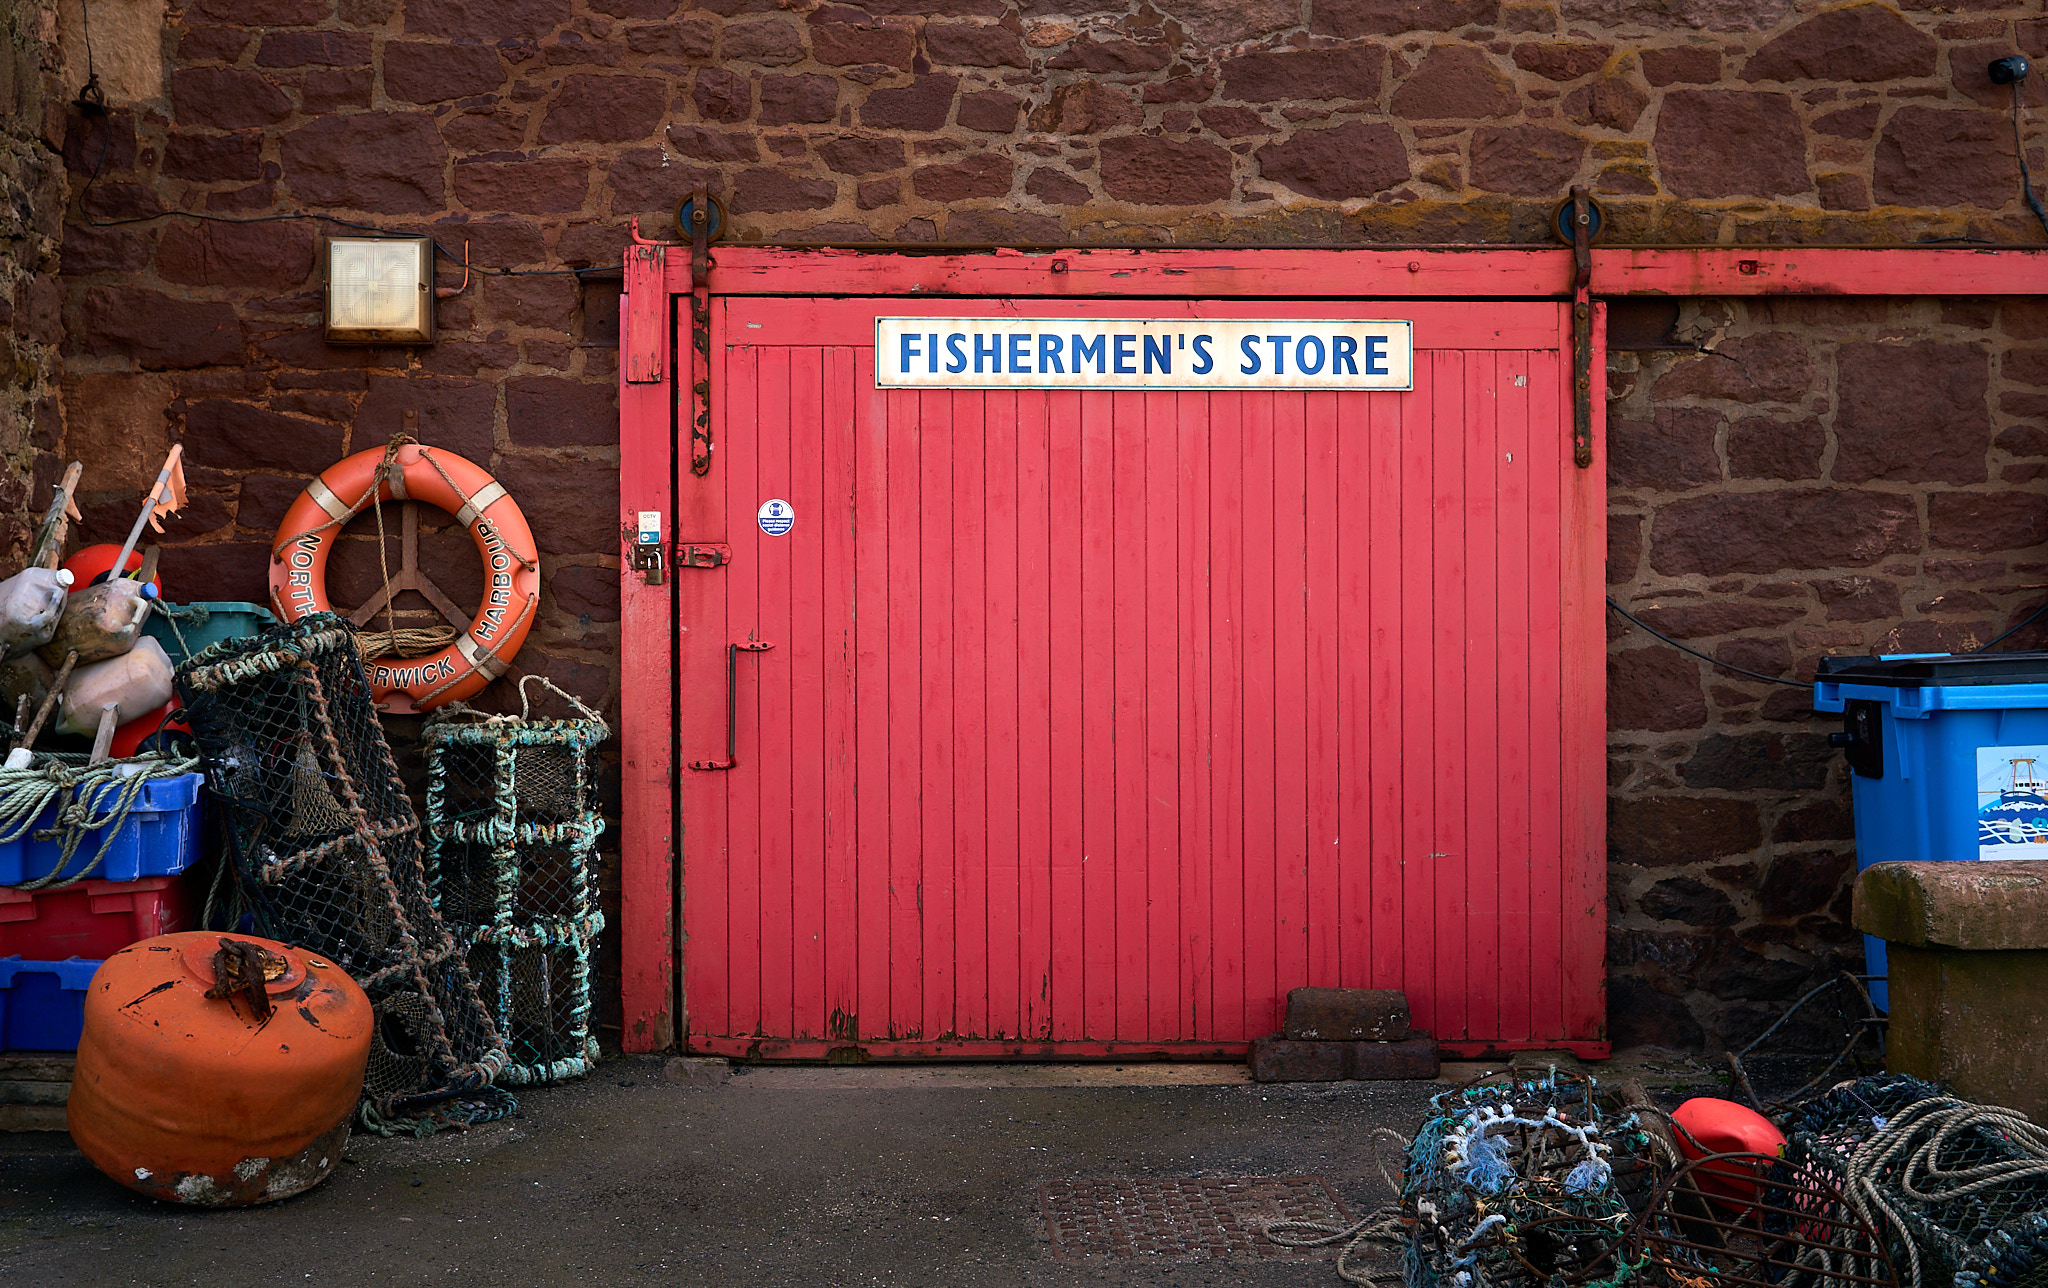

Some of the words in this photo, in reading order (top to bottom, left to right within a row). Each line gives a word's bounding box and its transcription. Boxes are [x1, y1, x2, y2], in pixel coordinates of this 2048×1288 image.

[899, 332, 1214, 375] FISHERMEN'S
[1239, 334, 1389, 375] STORE
[289, 534, 322, 618] NORTH
[363, 655, 456, 689] ERWICK
[475, 518, 512, 639] HARBOUR
